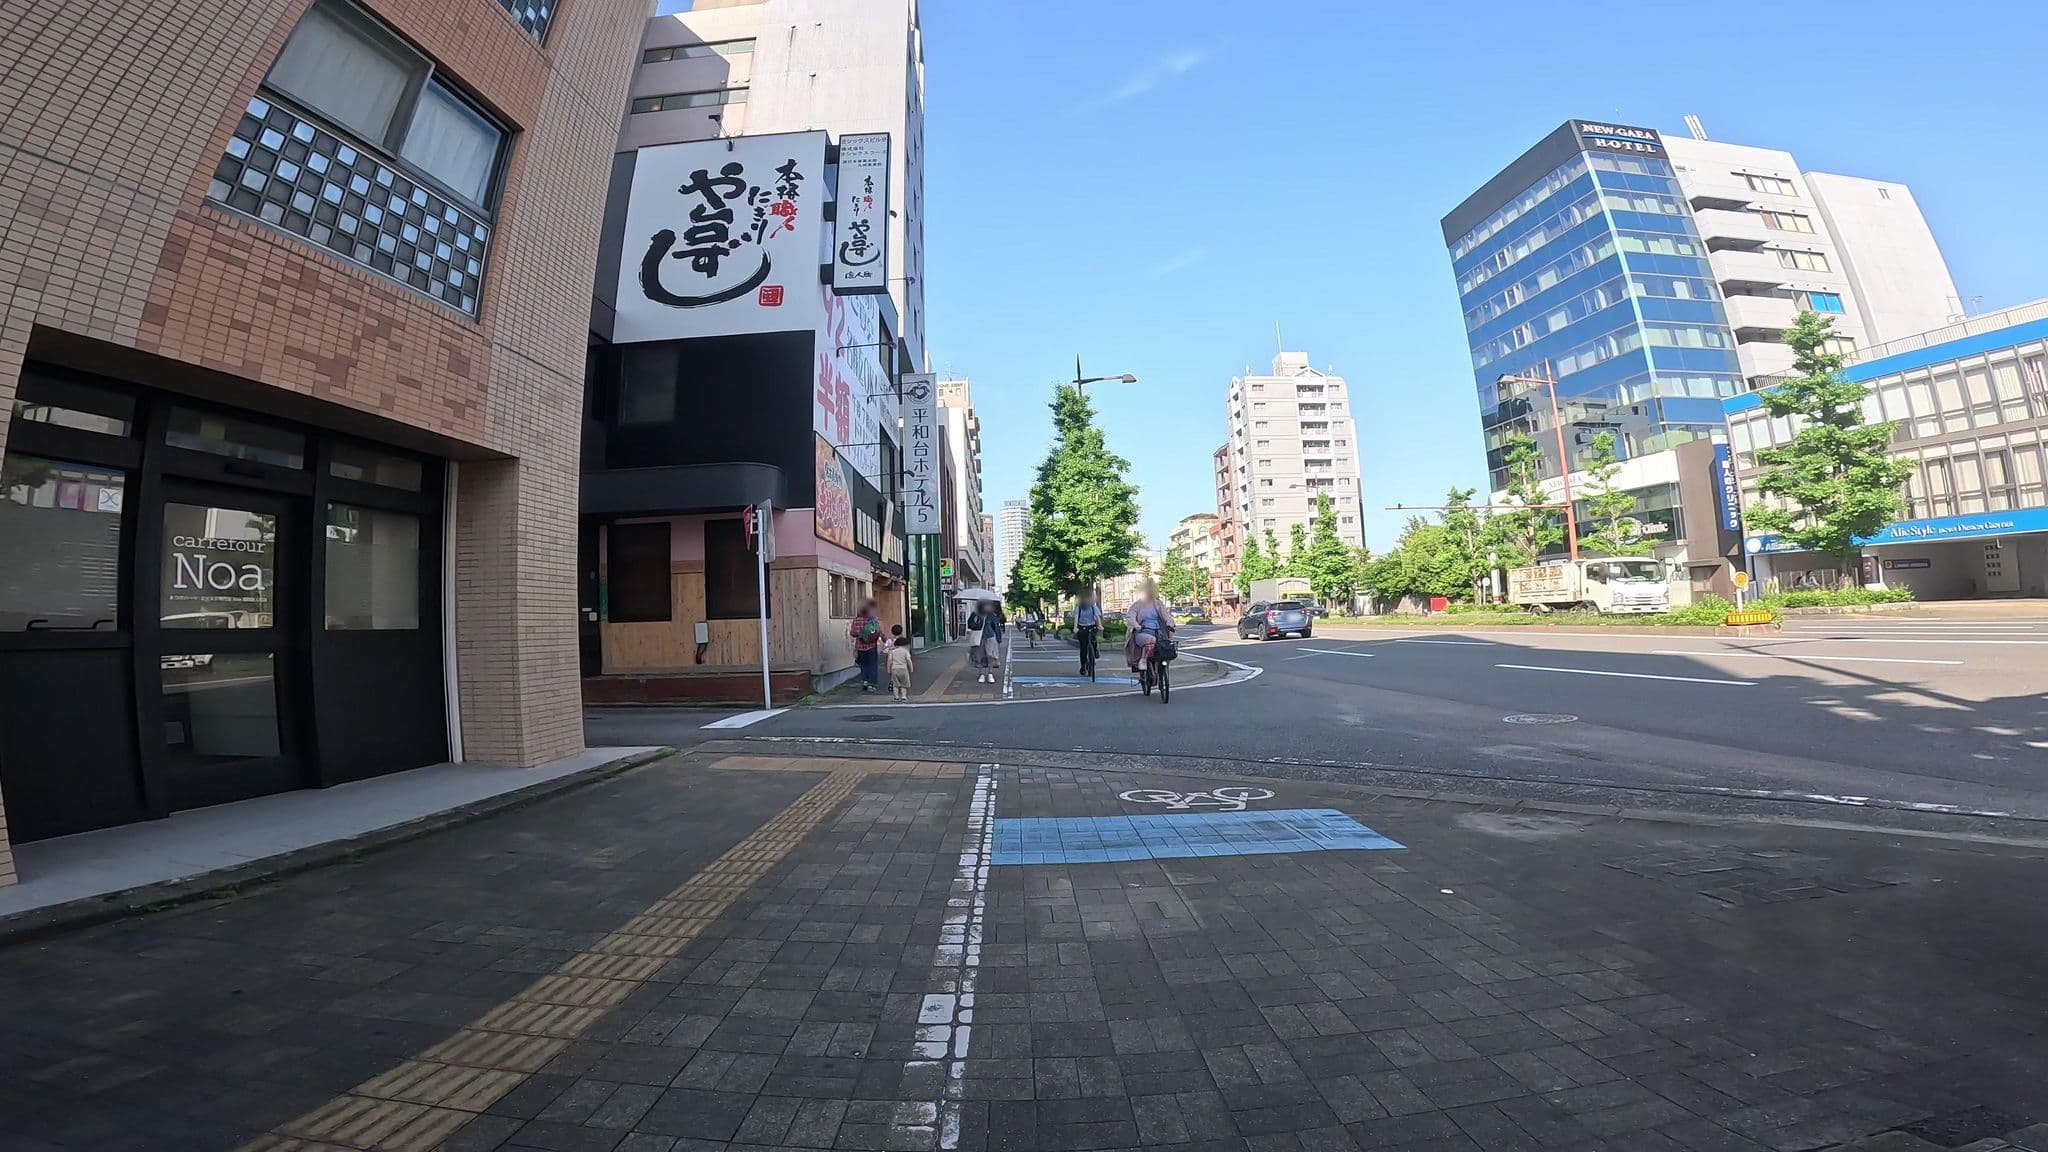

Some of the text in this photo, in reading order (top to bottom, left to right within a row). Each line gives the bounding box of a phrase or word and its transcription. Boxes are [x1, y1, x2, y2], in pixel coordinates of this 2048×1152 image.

[1581, 124, 1613, 135] NEW
[1595, 138, 1657, 153] HOTEL
[911, 408, 931, 523] 平和台ホテル5
[172, 535, 266, 554] carrefour
[172, 552, 266, 591] Noa
